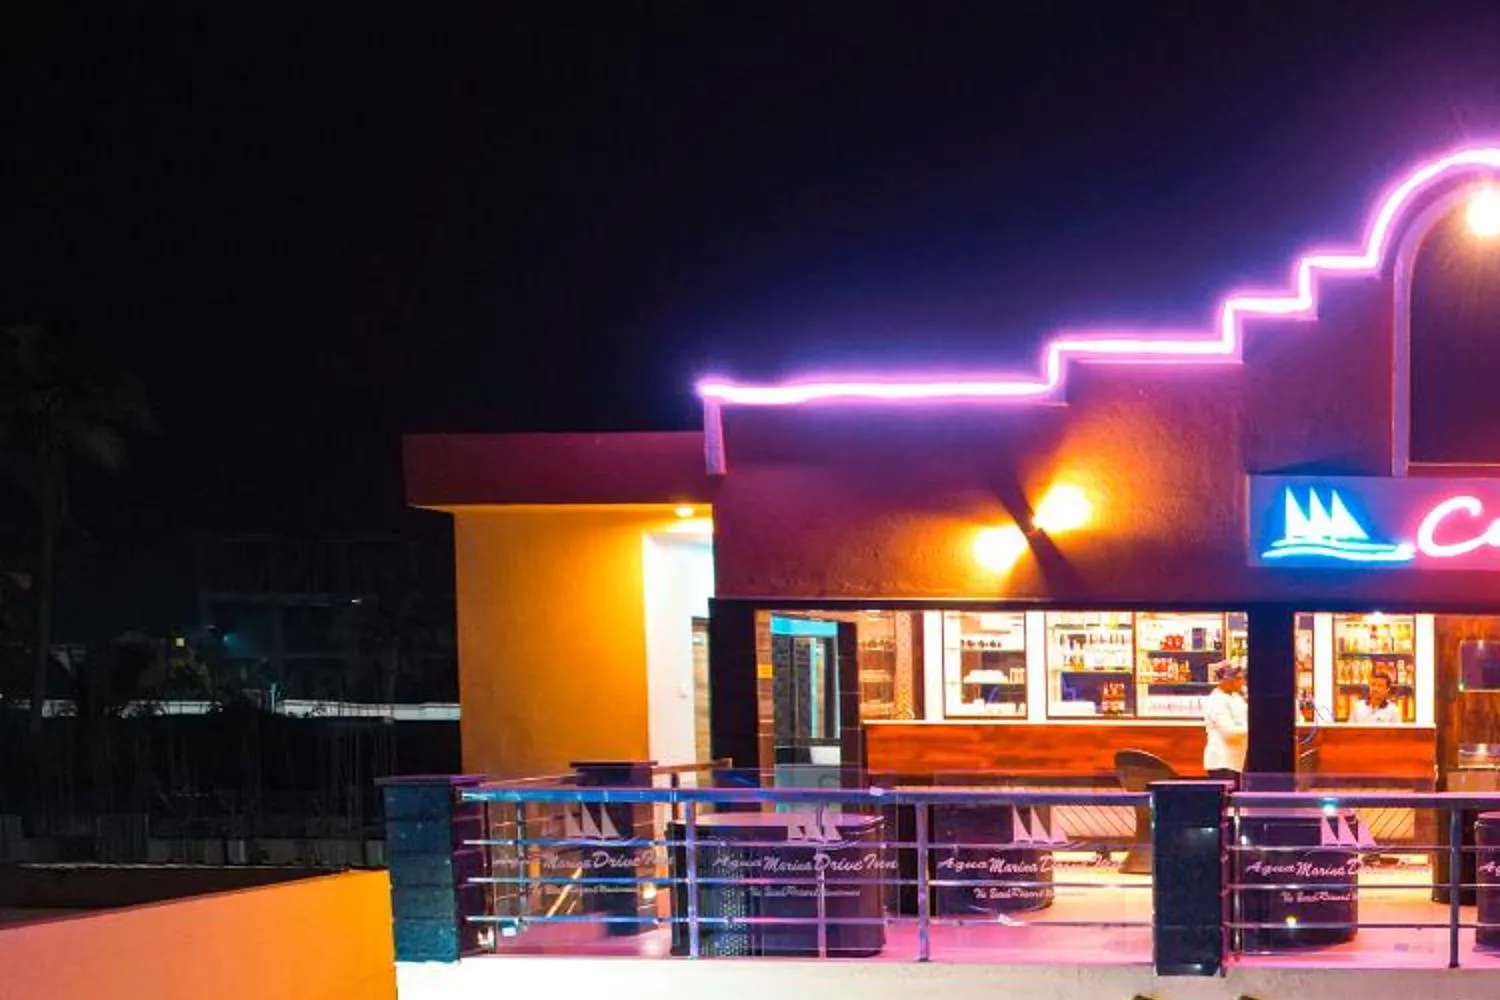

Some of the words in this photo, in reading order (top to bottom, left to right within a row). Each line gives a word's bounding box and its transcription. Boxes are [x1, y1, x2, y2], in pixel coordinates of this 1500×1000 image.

[813, 853, 864, 872] Drive
[988, 857, 1039, 873] Marina
[1296, 861, 1347, 877] Marina
